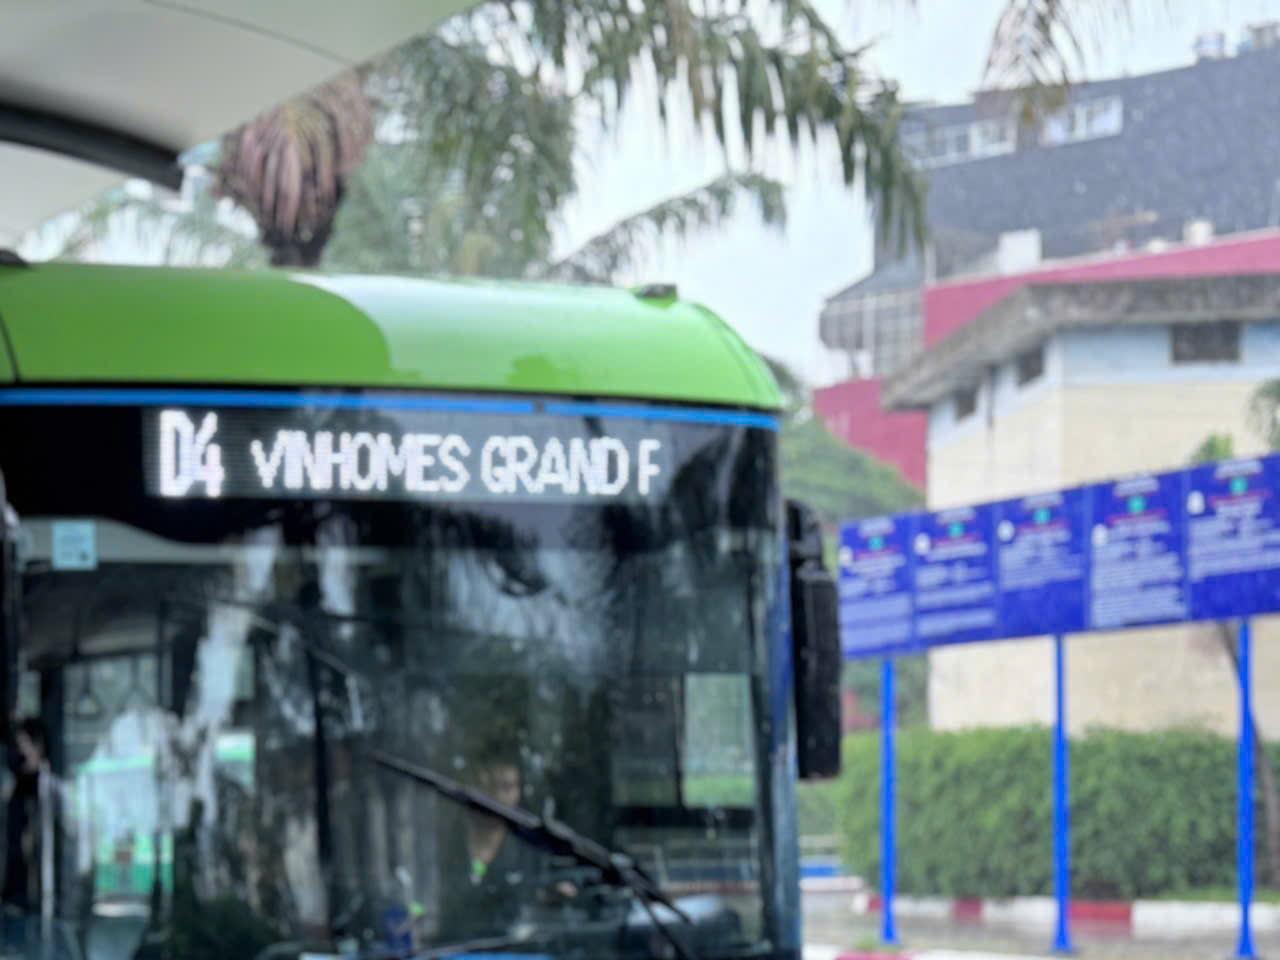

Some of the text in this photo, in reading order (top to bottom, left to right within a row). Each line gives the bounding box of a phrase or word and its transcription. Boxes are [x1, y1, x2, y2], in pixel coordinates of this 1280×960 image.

[160, 409, 224, 497] D4
[250, 429, 470, 492] VINHOMES
[480, 435, 629, 495] GRAND
